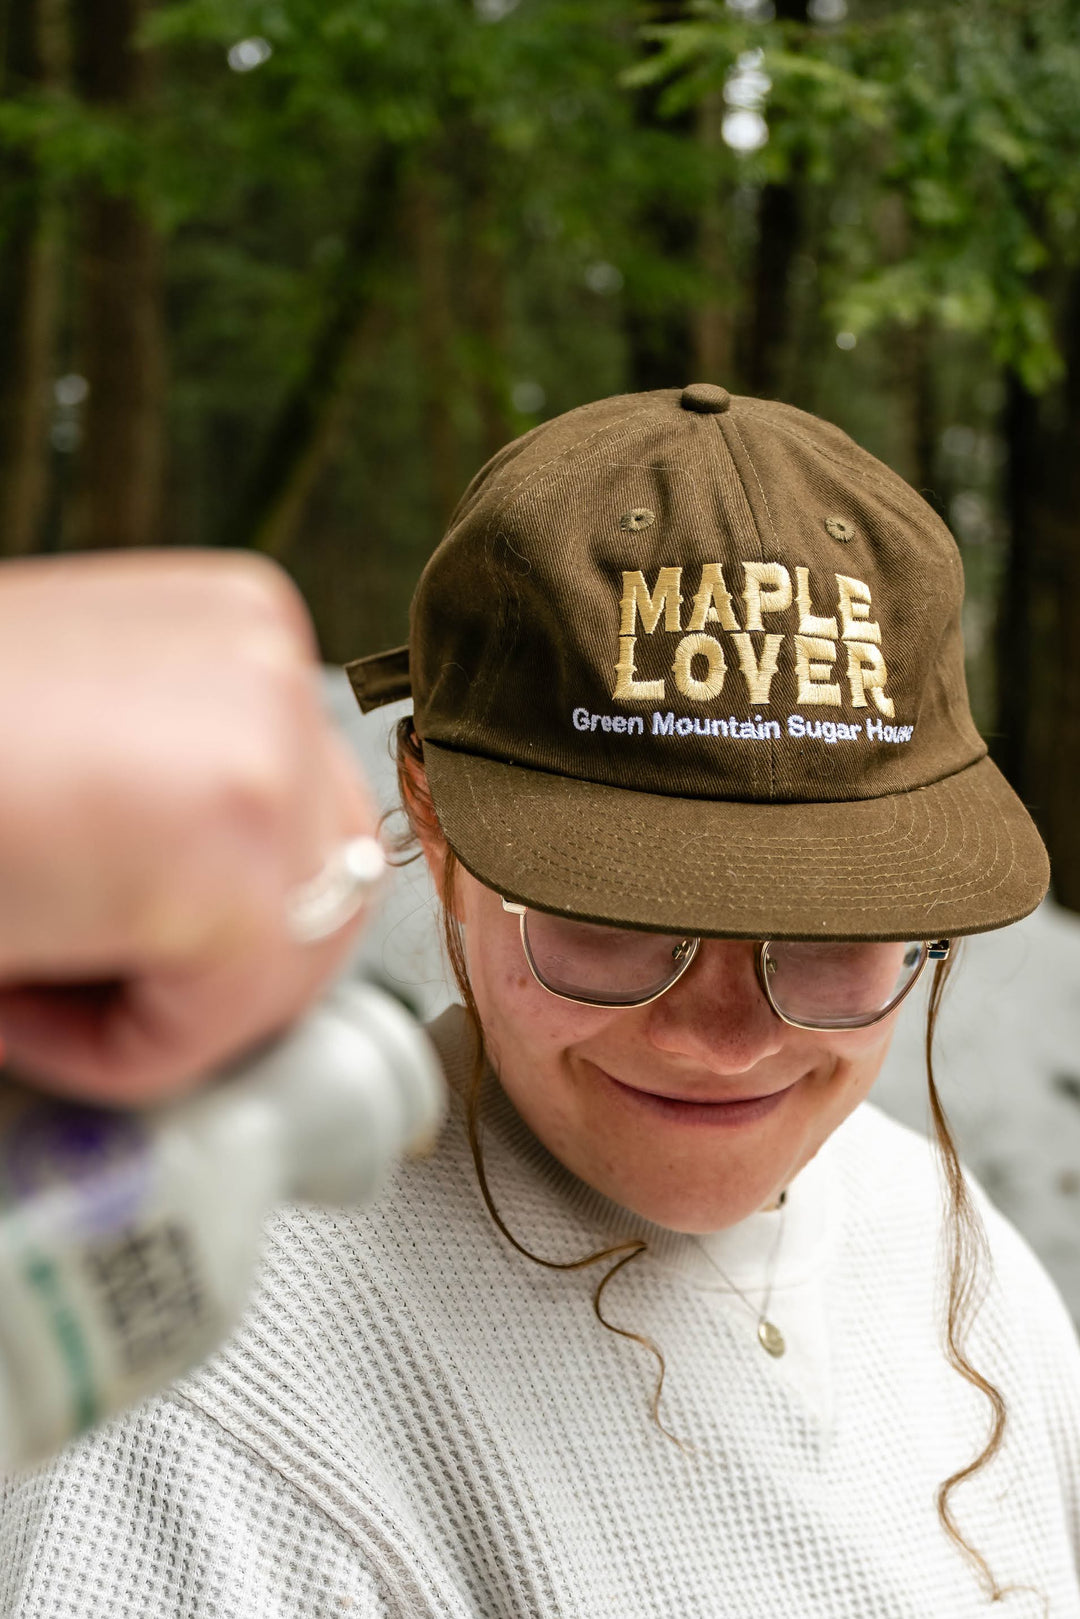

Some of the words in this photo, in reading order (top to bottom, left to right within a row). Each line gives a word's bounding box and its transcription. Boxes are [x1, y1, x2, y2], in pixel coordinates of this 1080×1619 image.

[619, 561, 881, 645] MAPLE
[612, 633, 895, 718] LOVER
[572, 707, 644, 735] Green
[652, 711, 781, 741] Mountain
[787, 714, 862, 744] Sugar
